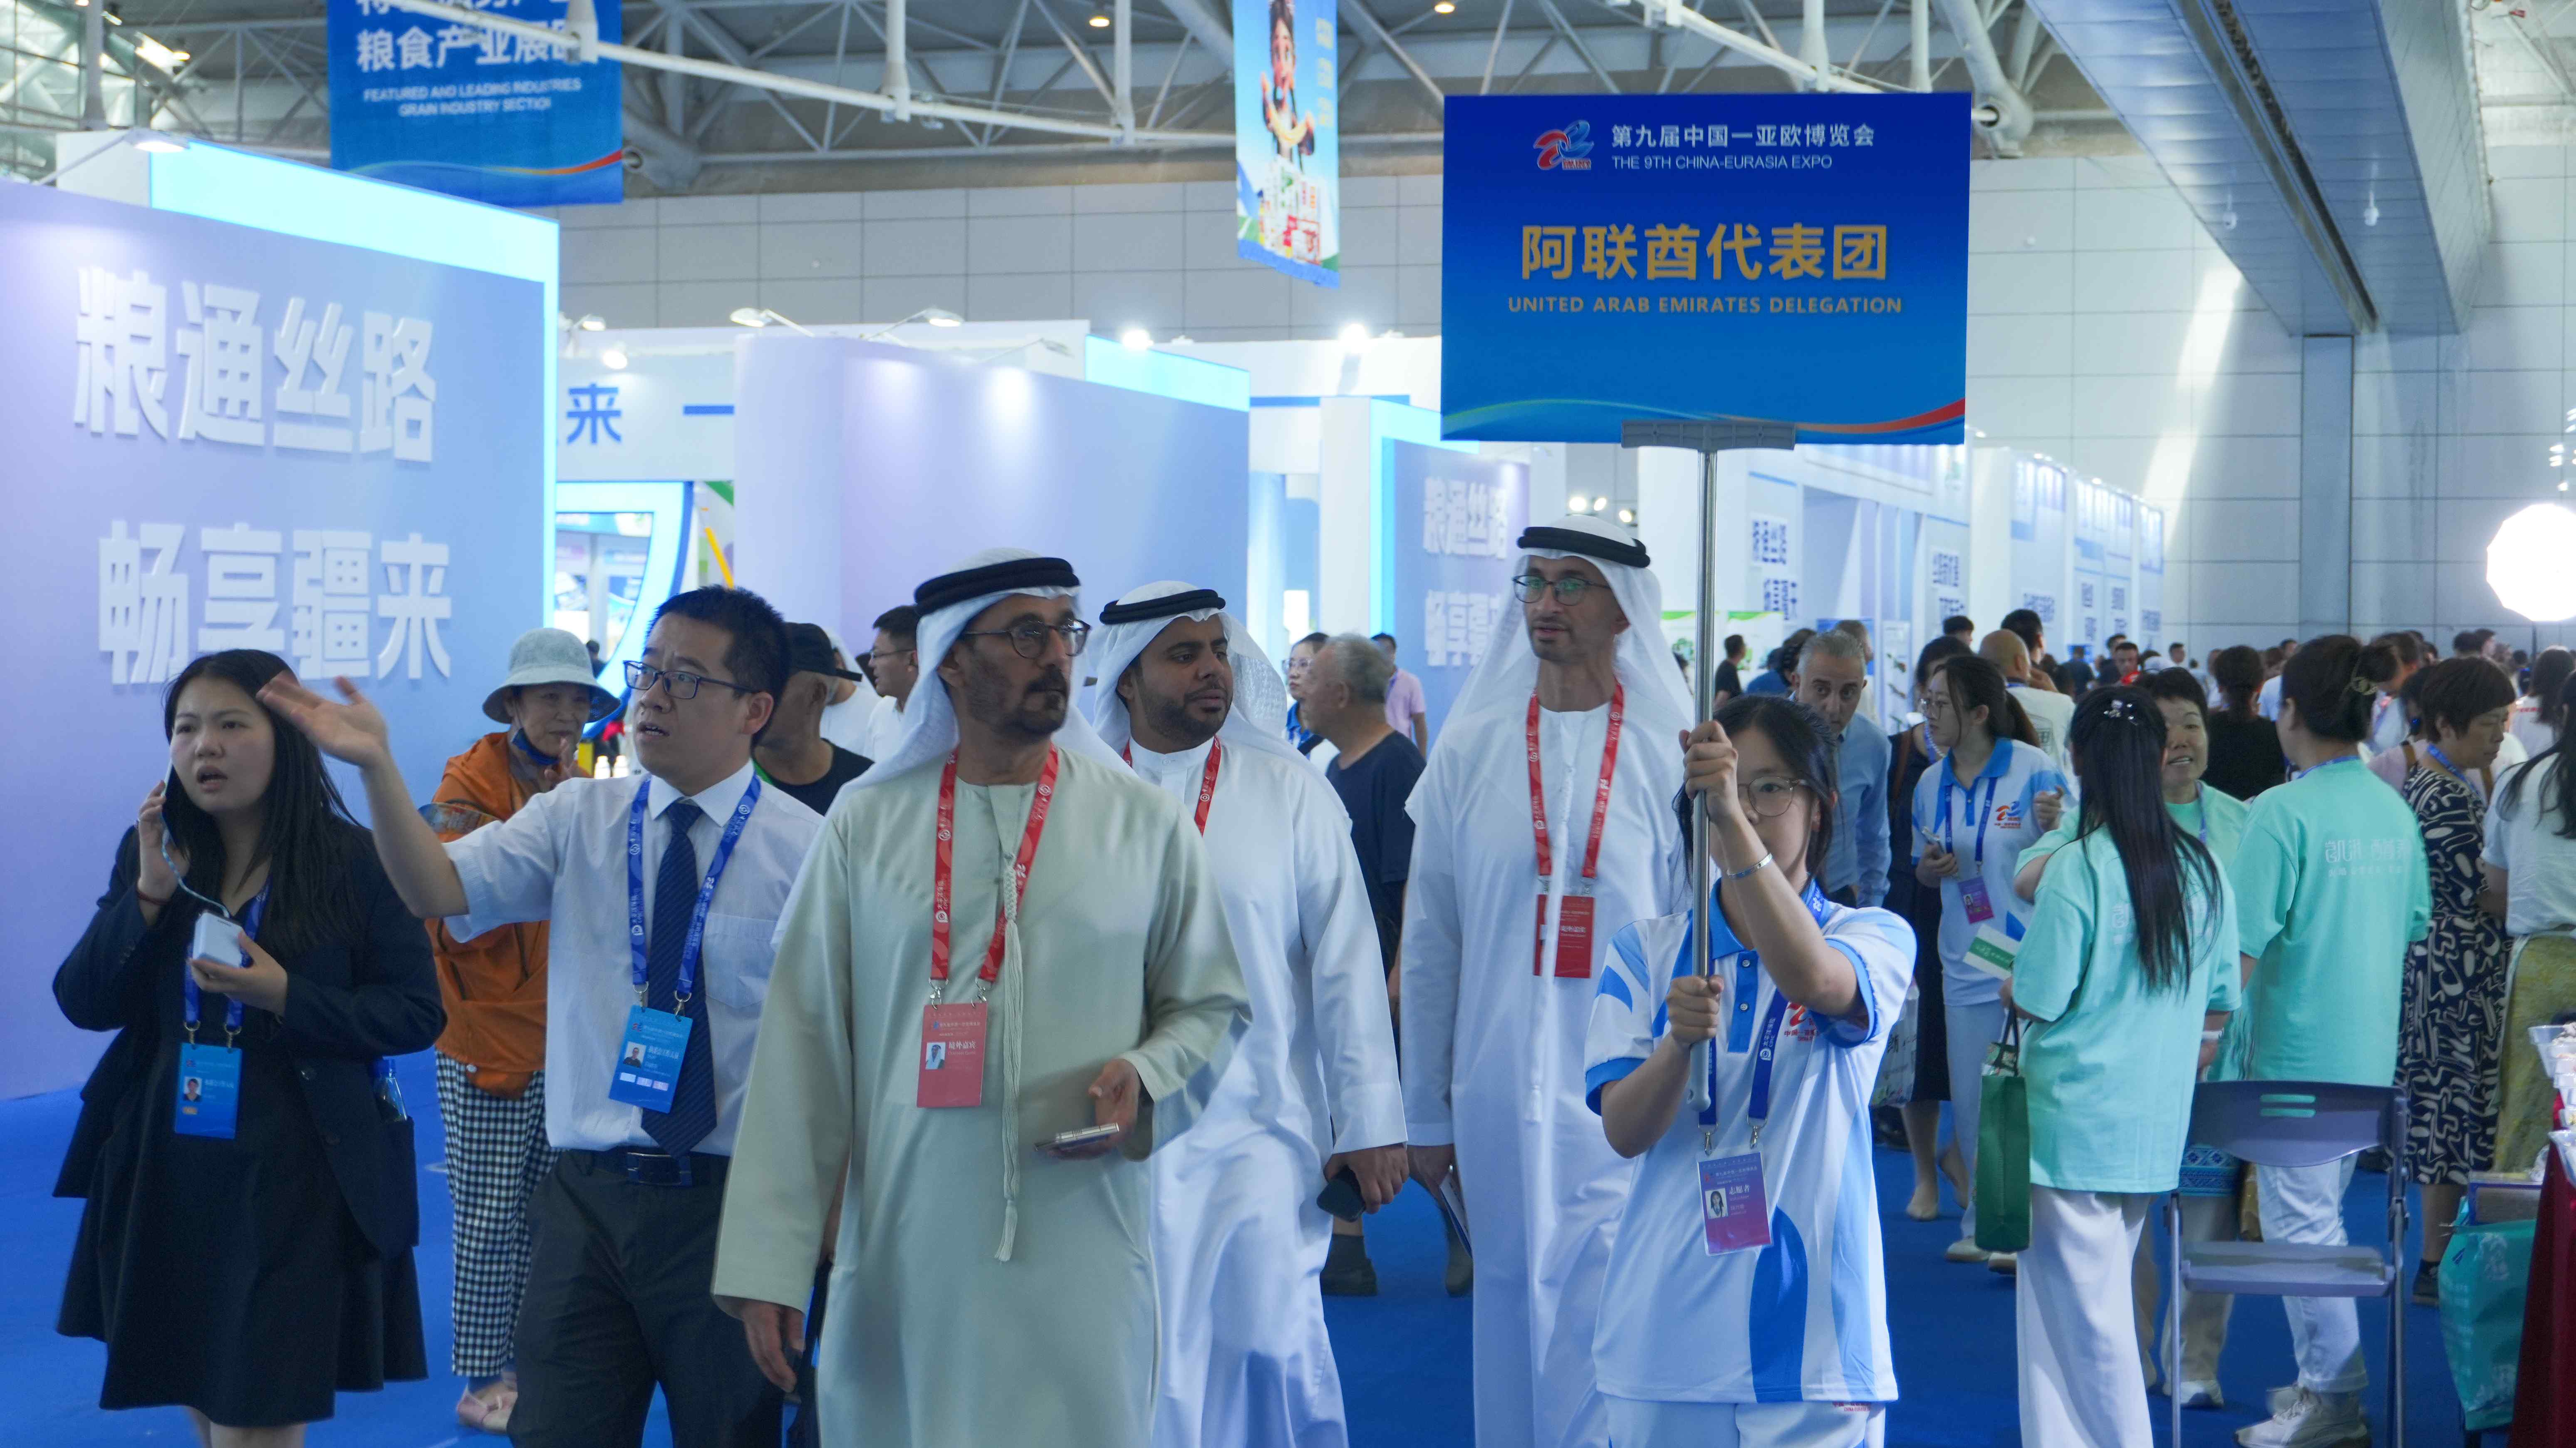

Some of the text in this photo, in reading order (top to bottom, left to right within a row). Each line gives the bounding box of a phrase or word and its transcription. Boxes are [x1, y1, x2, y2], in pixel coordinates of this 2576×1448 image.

[363, 78, 581, 102] FEATURED AND LEADING INDUSTRIES
[398, 103, 438, 117] GRAIN
[439, 99, 499, 114] INDUSTRY
[1612, 155, 1832, 169] THE 9TH CHINA-EURASIA EXPO
[1522, 223, 1887, 281] 阿联酋代表团
[1508, 297, 1902, 314] UNITED ARAB EMIRATES DELEGATION
[73, 265, 436, 463] 粮通丝路
[98, 520, 452, 685] 畅享疆来
